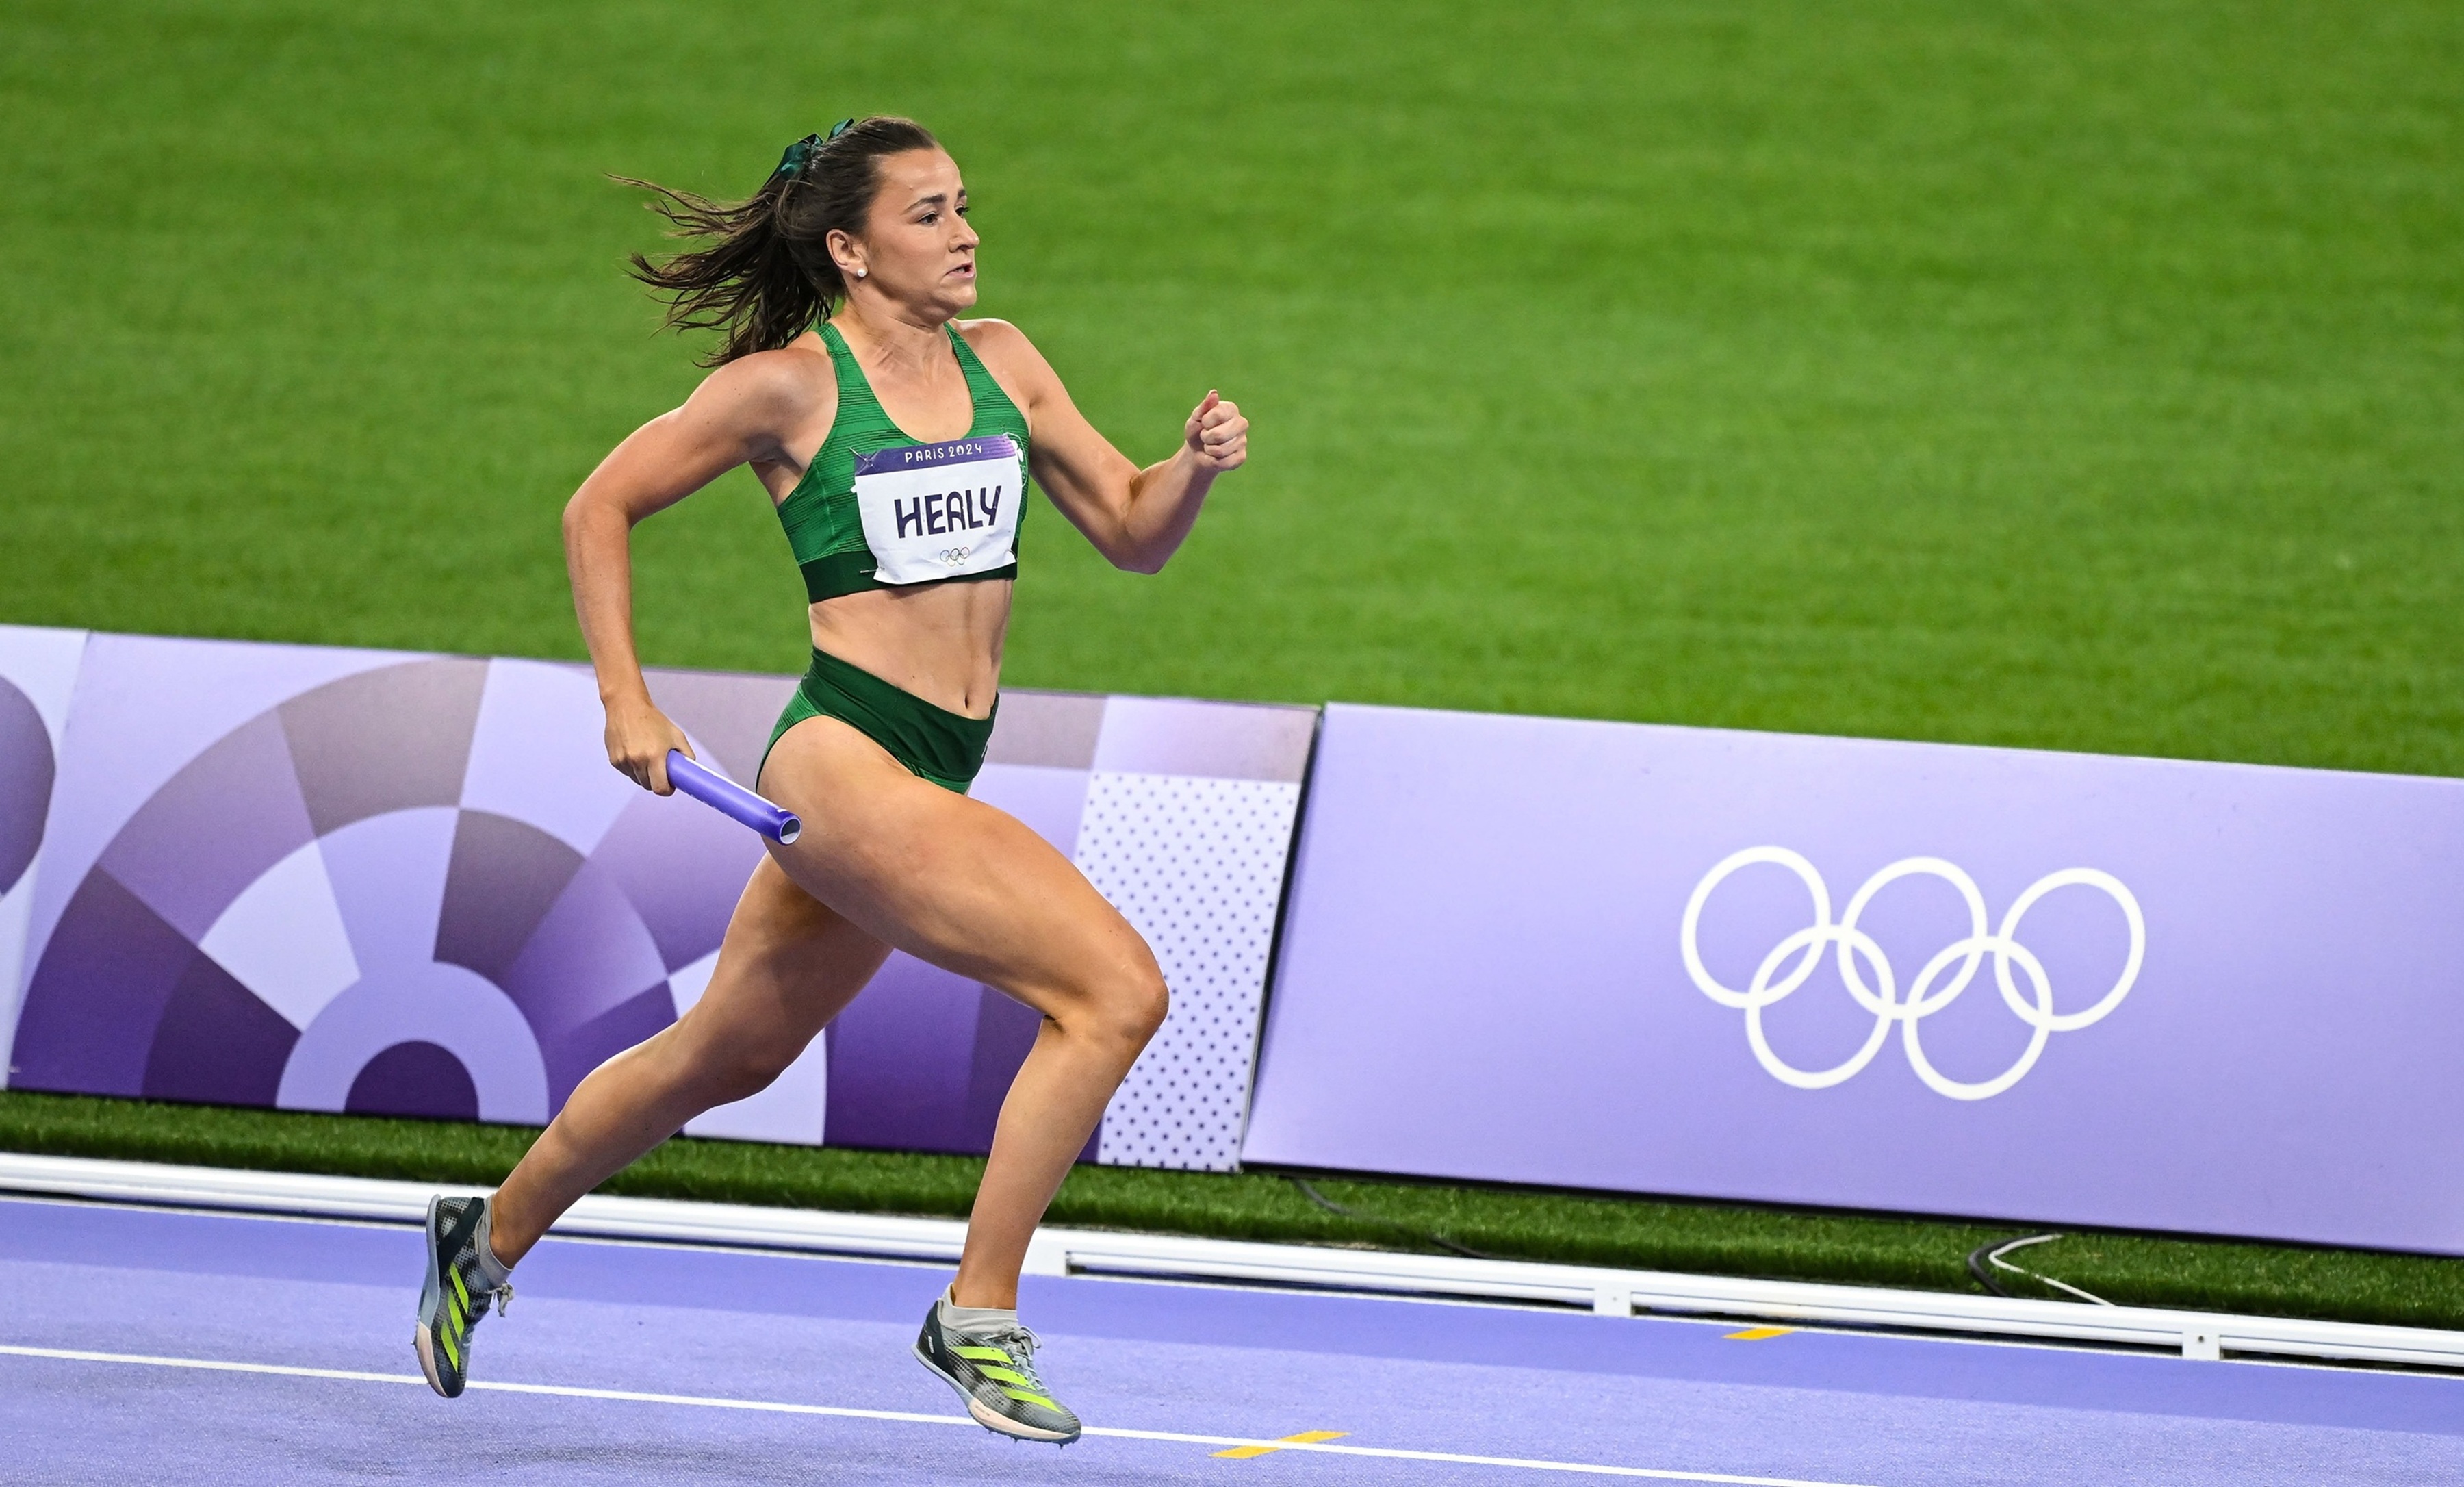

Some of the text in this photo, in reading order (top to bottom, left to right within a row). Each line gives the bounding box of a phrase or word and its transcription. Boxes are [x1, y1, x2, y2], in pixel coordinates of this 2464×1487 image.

[905, 443, 982, 463] PARIS 2024
[894, 485, 1001, 539] HEALY
